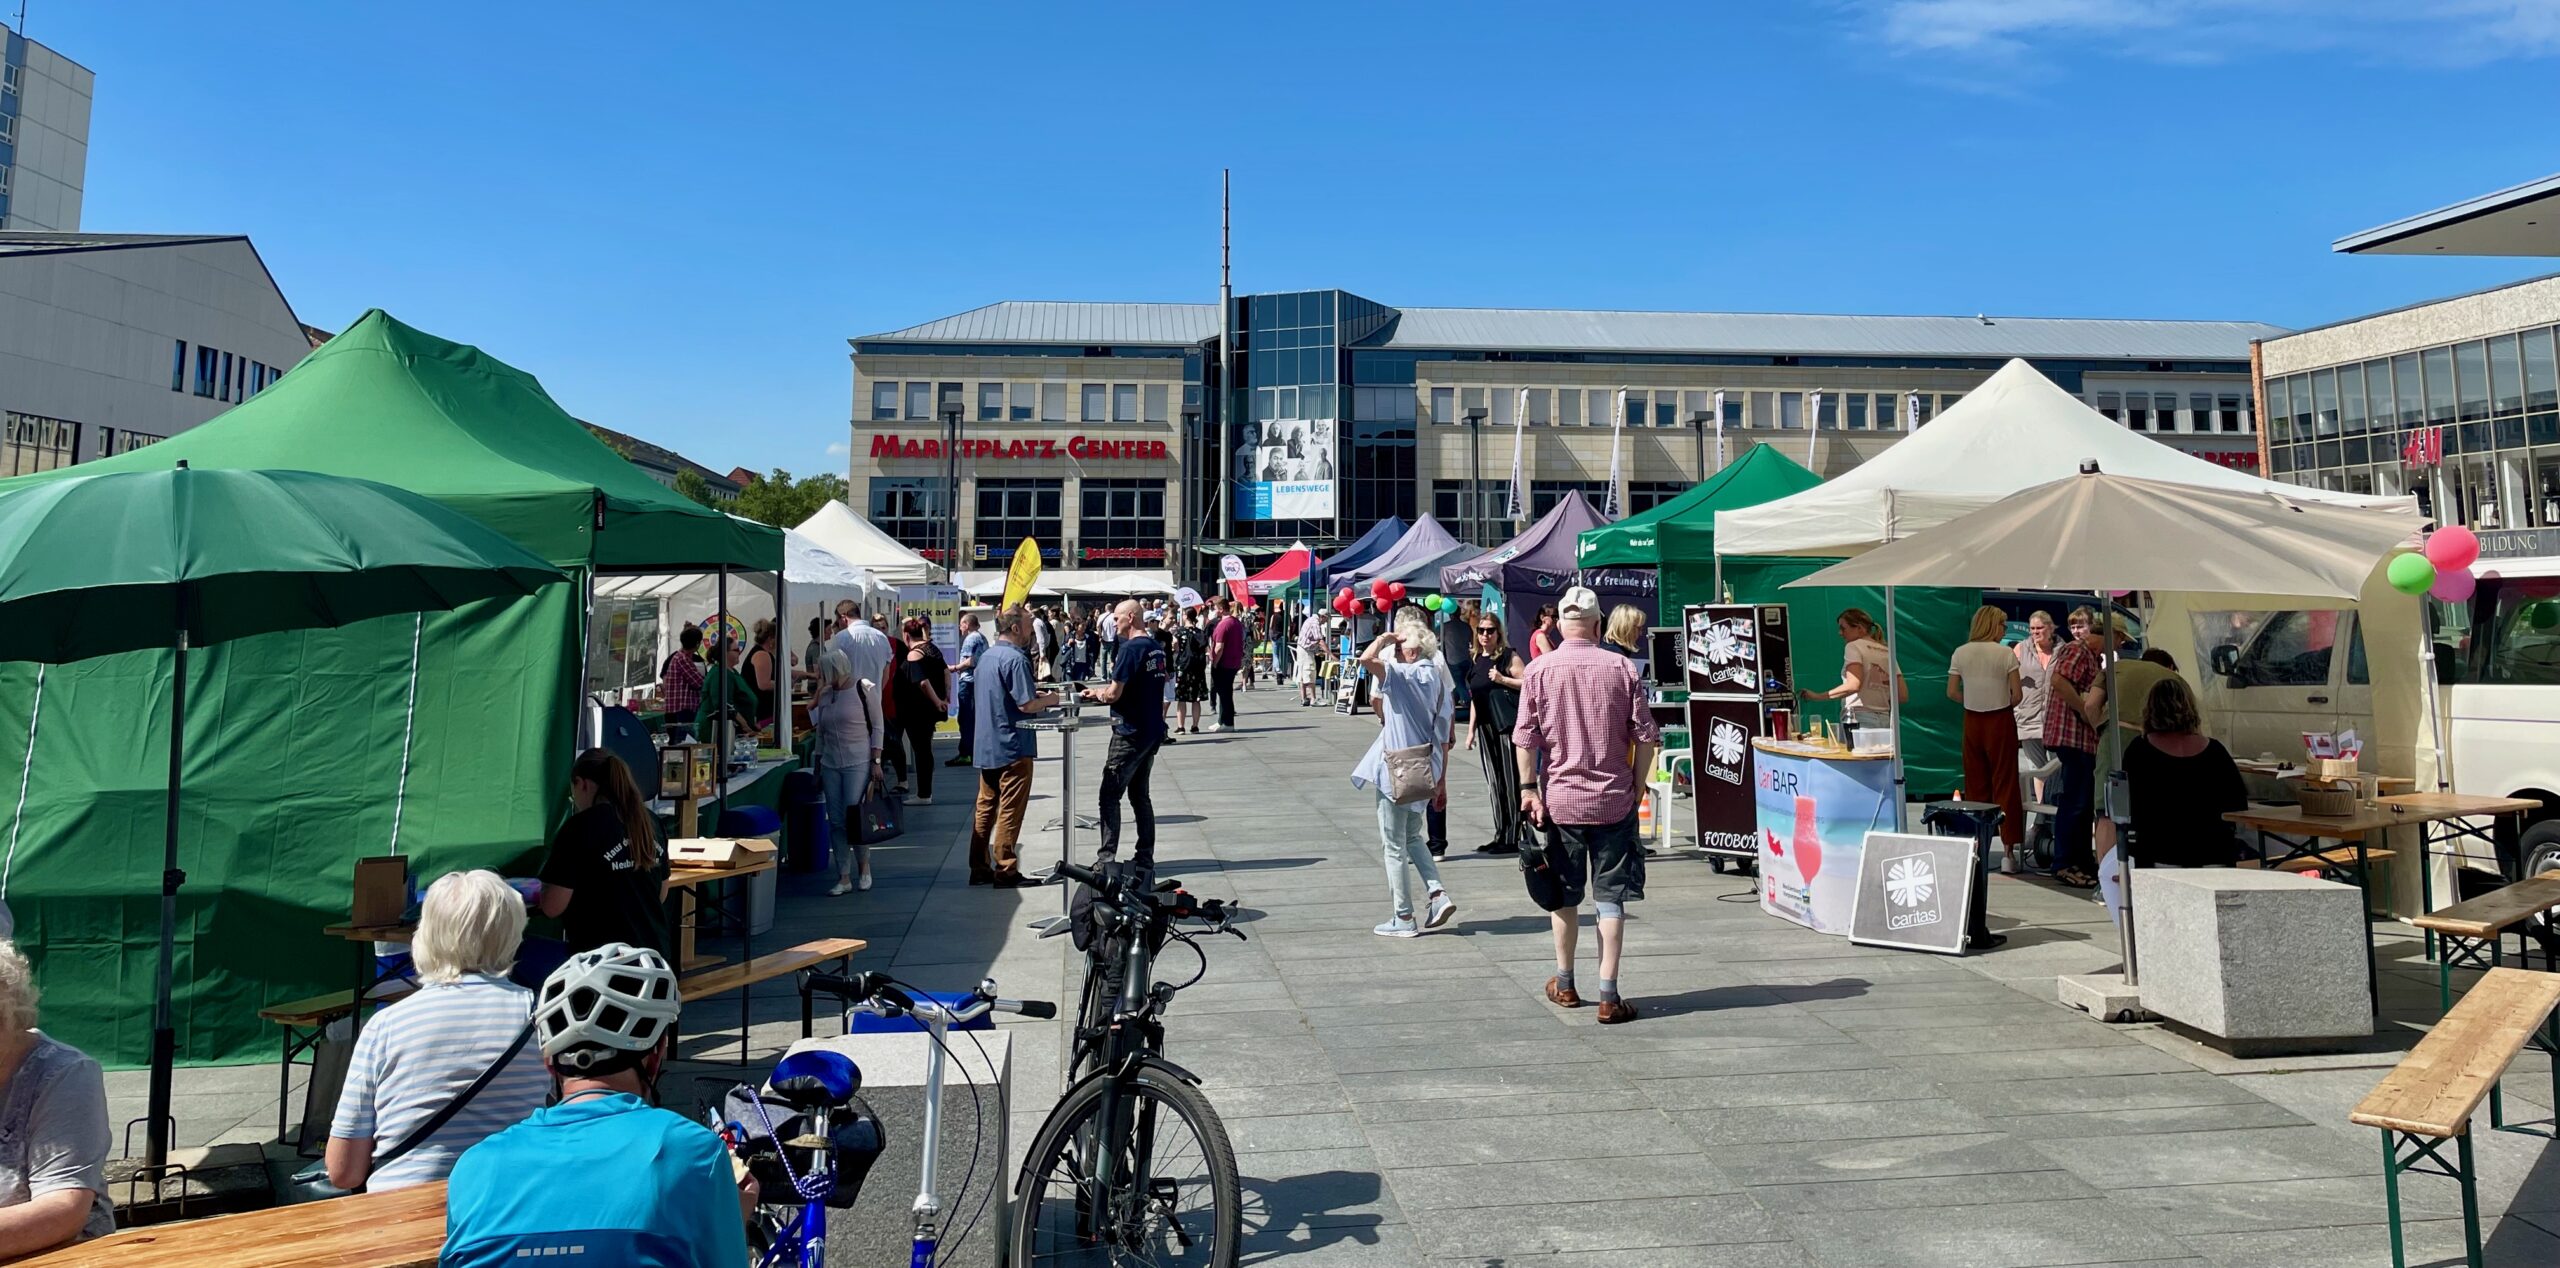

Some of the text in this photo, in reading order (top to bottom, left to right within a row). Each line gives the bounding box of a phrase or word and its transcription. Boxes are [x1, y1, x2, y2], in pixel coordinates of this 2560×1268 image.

[2403, 427, 2442, 469] H&M
[1276, 484, 1329, 493] LEBENSWEGE
[2480, 534, 2537, 552] BILDUNG
[1604, 576, 1640, 587] Freunde
[907, 608, 952, 617] Blick auf
[1674, 633, 1683, 667] caritas
[1712, 666, 1738, 681] carita
[1708, 764, 1739, 782] caritas
[603, 843, 623, 861] Haus
[1892, 909, 1937, 927] caritas
